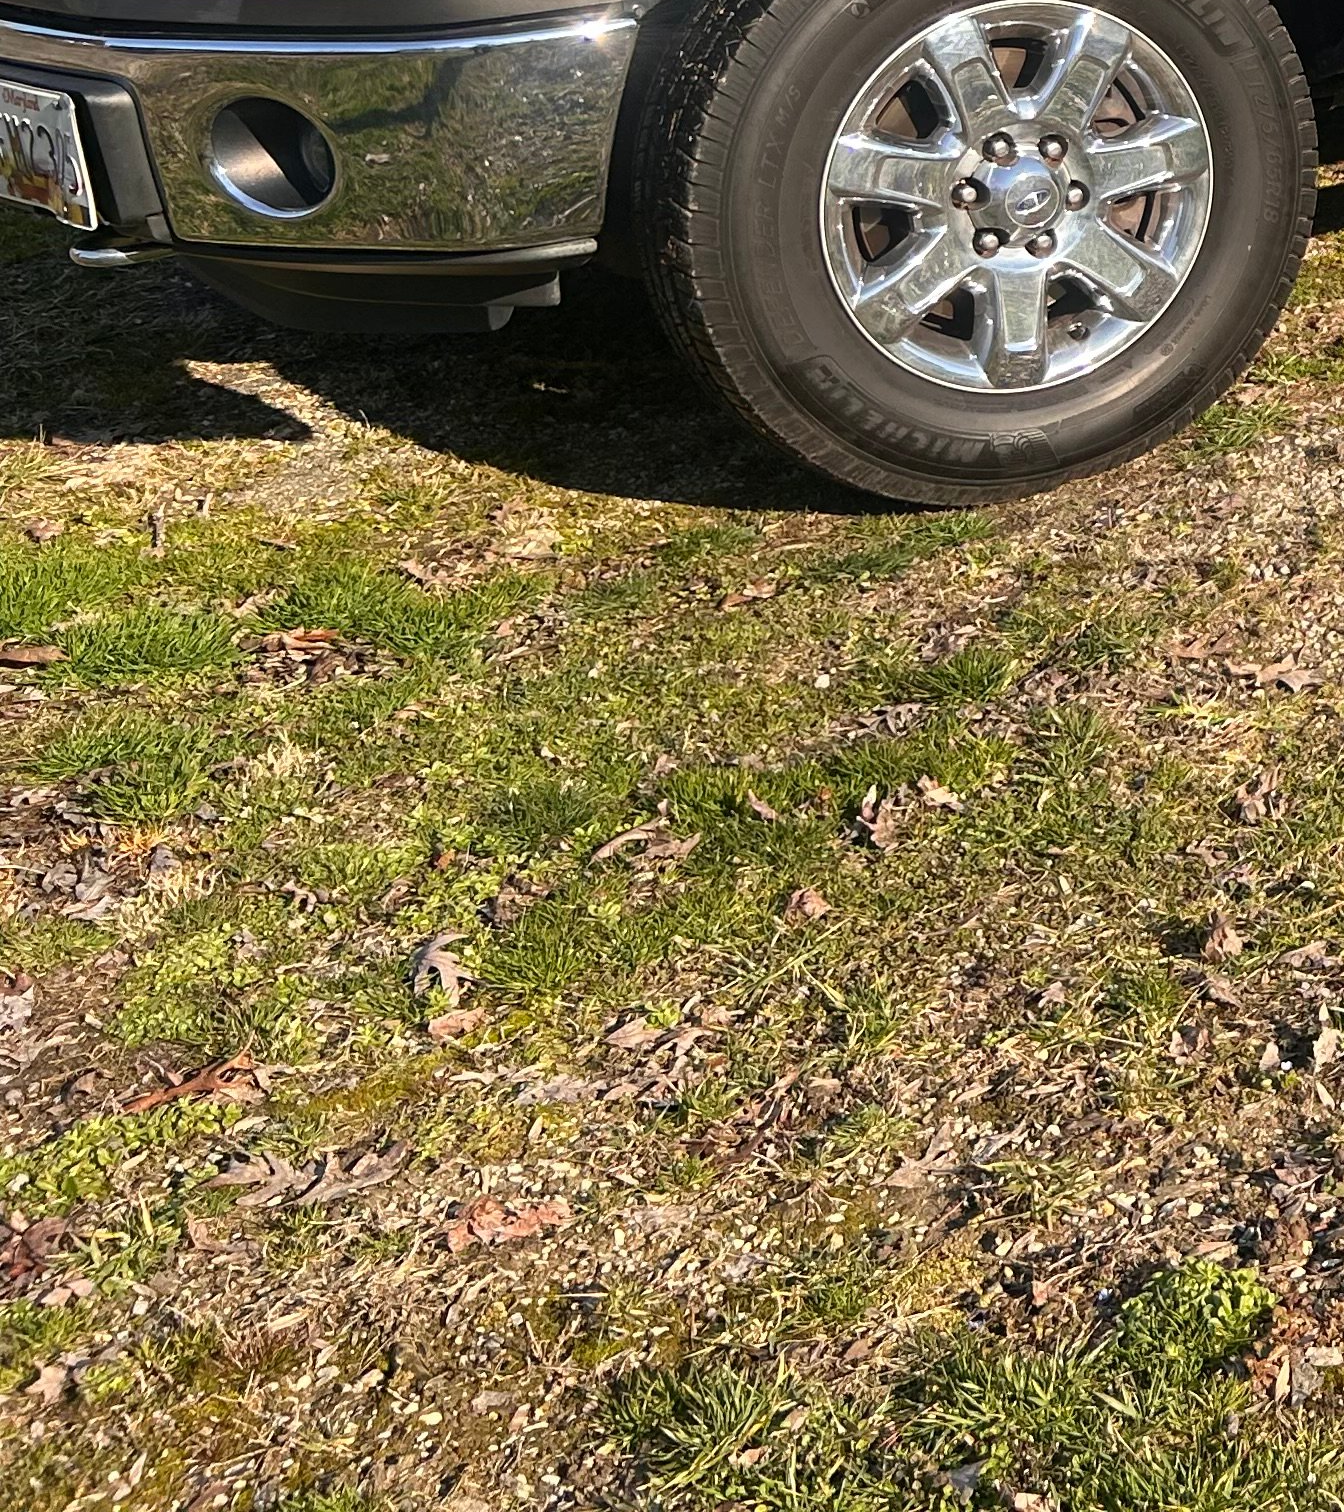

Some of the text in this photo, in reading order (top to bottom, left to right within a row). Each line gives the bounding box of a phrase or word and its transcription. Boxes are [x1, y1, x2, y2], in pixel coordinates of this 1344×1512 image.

[755, 84, 805, 348] DEFENDER LTX M/S
[805, 365, 987, 464] MICHELIN
